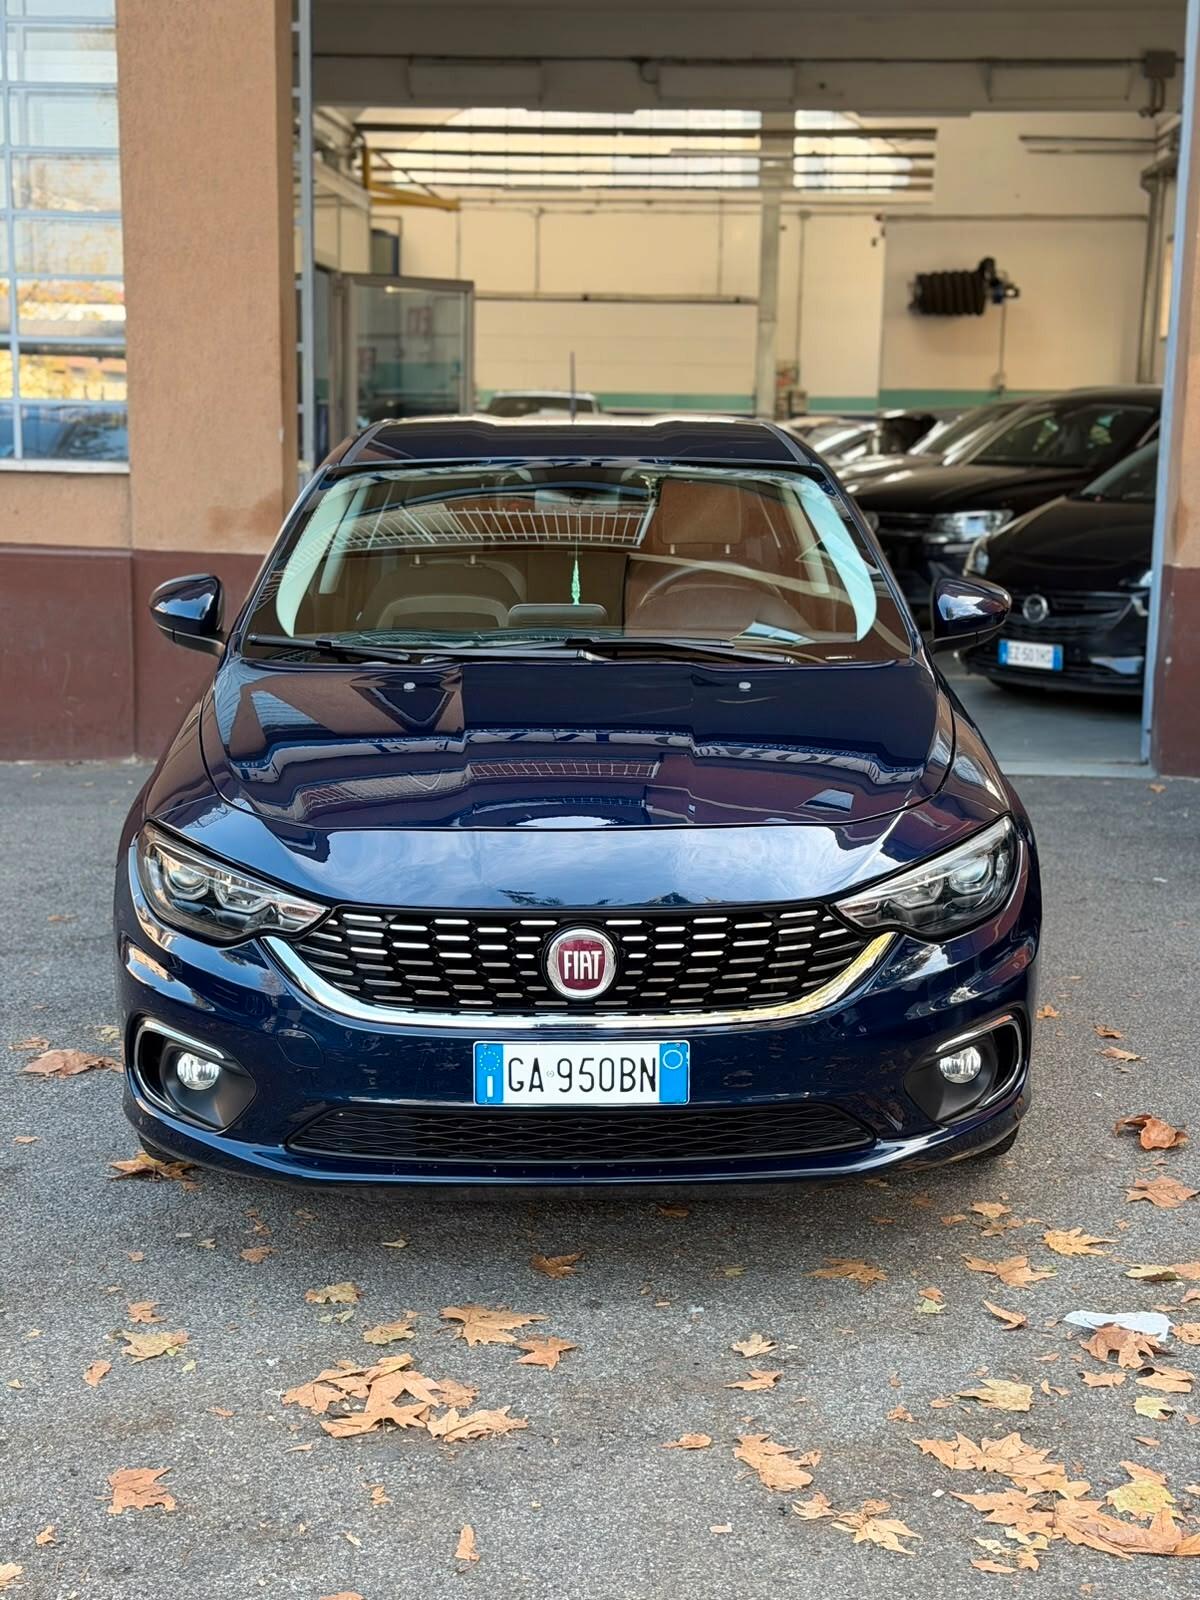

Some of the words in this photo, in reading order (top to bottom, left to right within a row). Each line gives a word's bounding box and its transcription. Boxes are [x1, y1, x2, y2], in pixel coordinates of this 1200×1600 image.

[563, 950, 602, 980] FIAT
[508, 1057, 544, 1092] GA
[557, 1057, 656, 1092] 950BN
